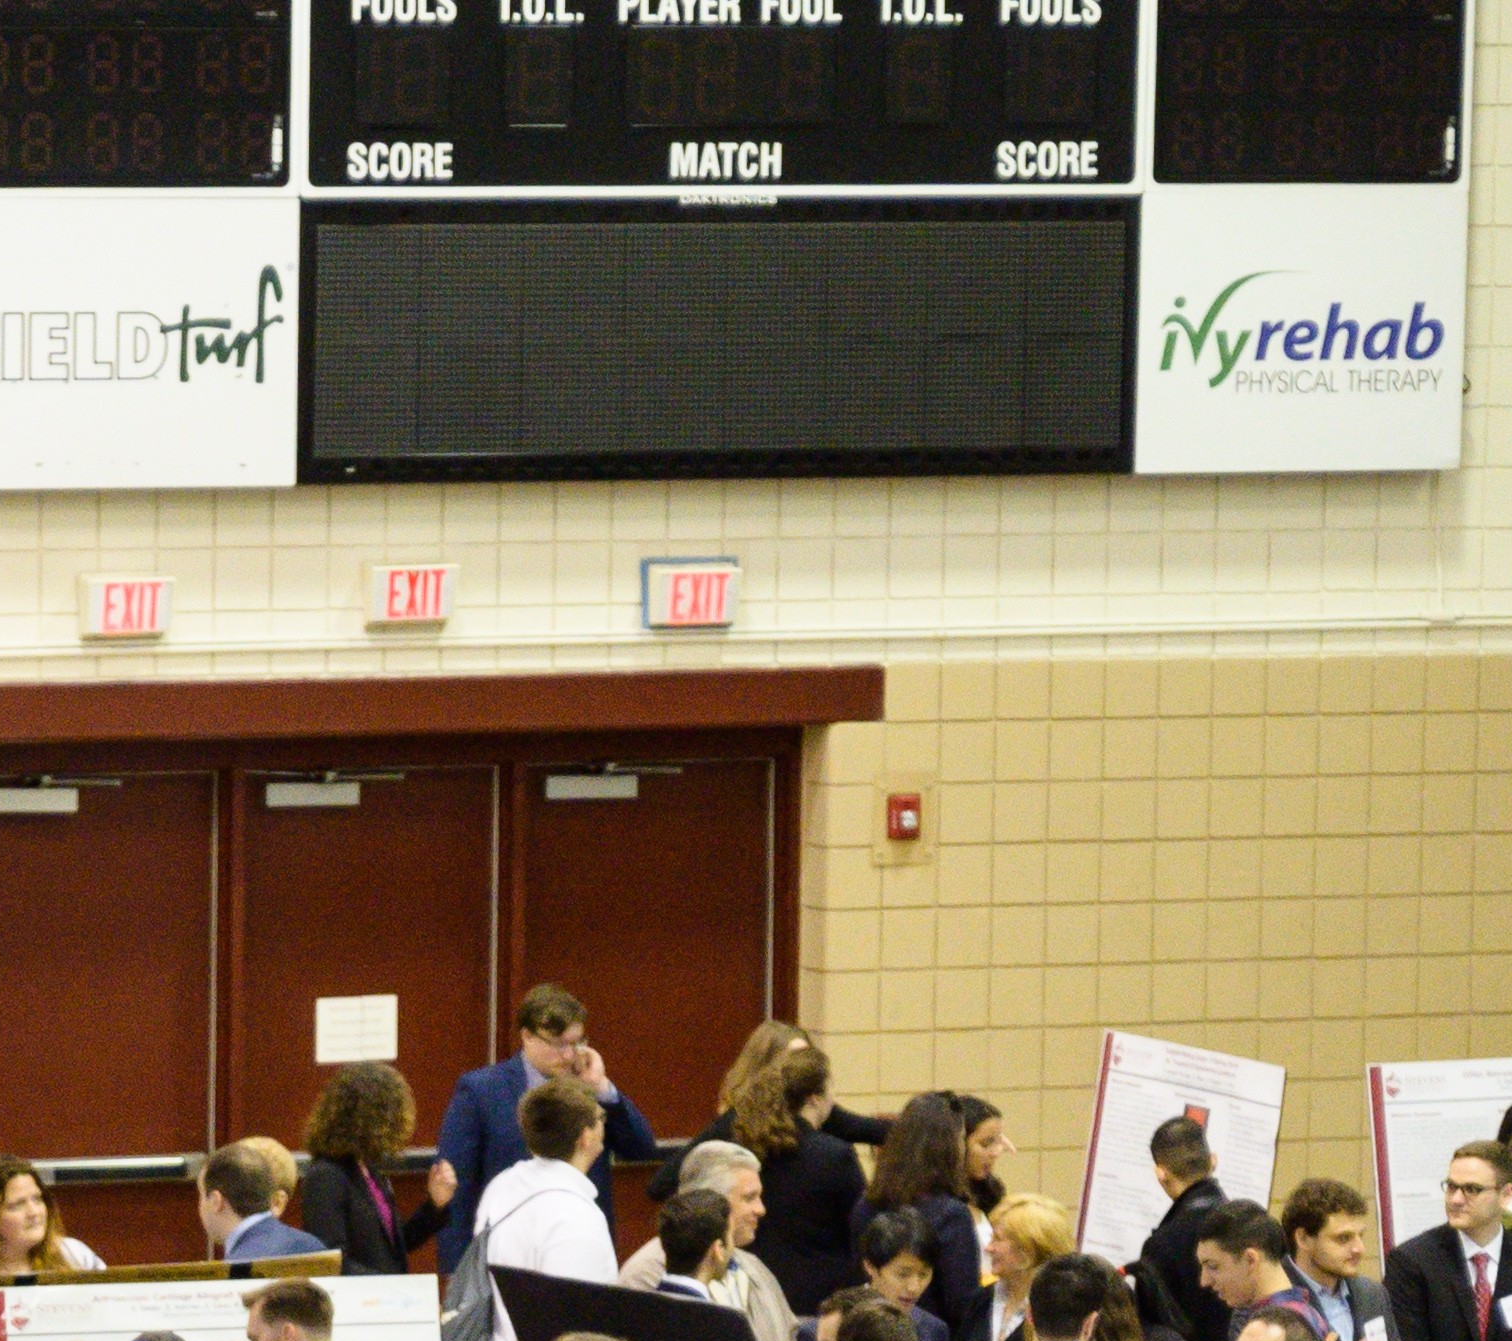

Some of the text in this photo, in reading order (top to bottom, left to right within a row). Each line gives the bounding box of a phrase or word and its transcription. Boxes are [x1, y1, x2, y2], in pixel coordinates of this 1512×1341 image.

[347, 143, 453, 178] SCORE
[670, 142, 782, 177] MATCH
[997, 141, 1099, 176] SCORE
[1235, 369, 1443, 393] PHYSICAL THERAPY
[101, 582, 162, 632] EXIT
[386, 570, 445, 618] EXIT
[668, 573, 730, 622] EXIT
